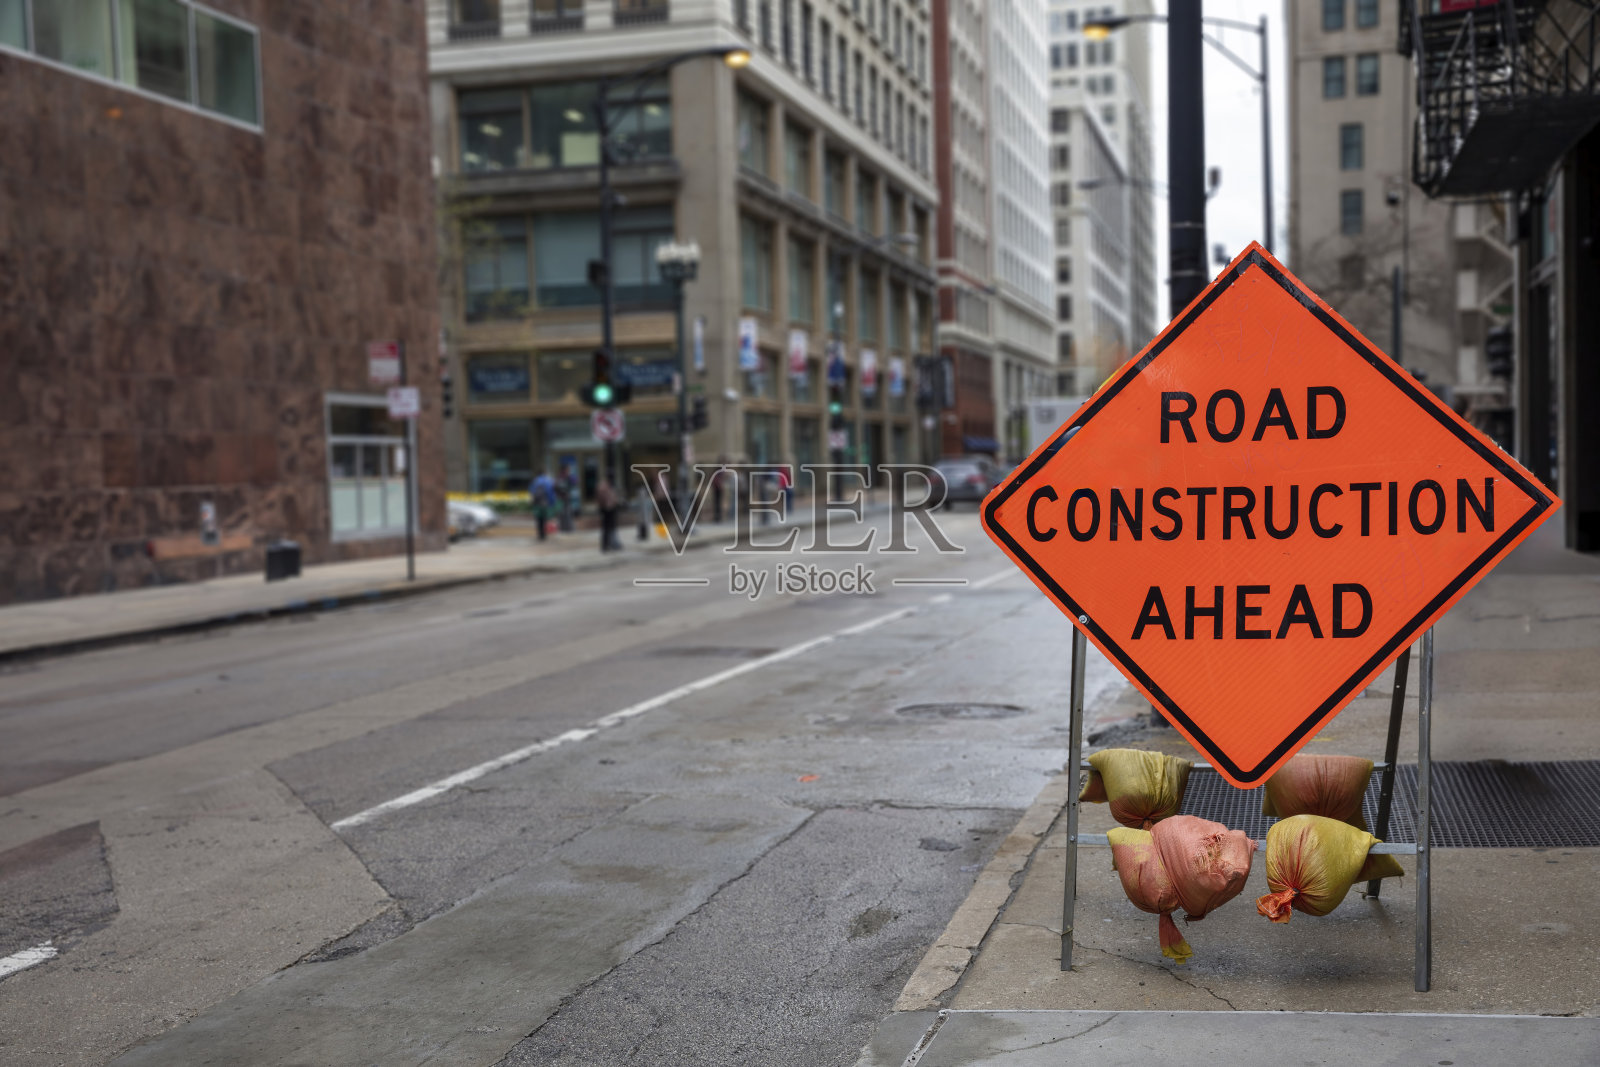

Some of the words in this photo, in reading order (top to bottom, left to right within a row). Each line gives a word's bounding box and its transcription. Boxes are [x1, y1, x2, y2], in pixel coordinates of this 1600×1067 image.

[1160, 385, 1347, 444] ROAD
[1026, 477, 1495, 543] CONSTRUCTION
[1130, 582, 1373, 640] AHEAD
